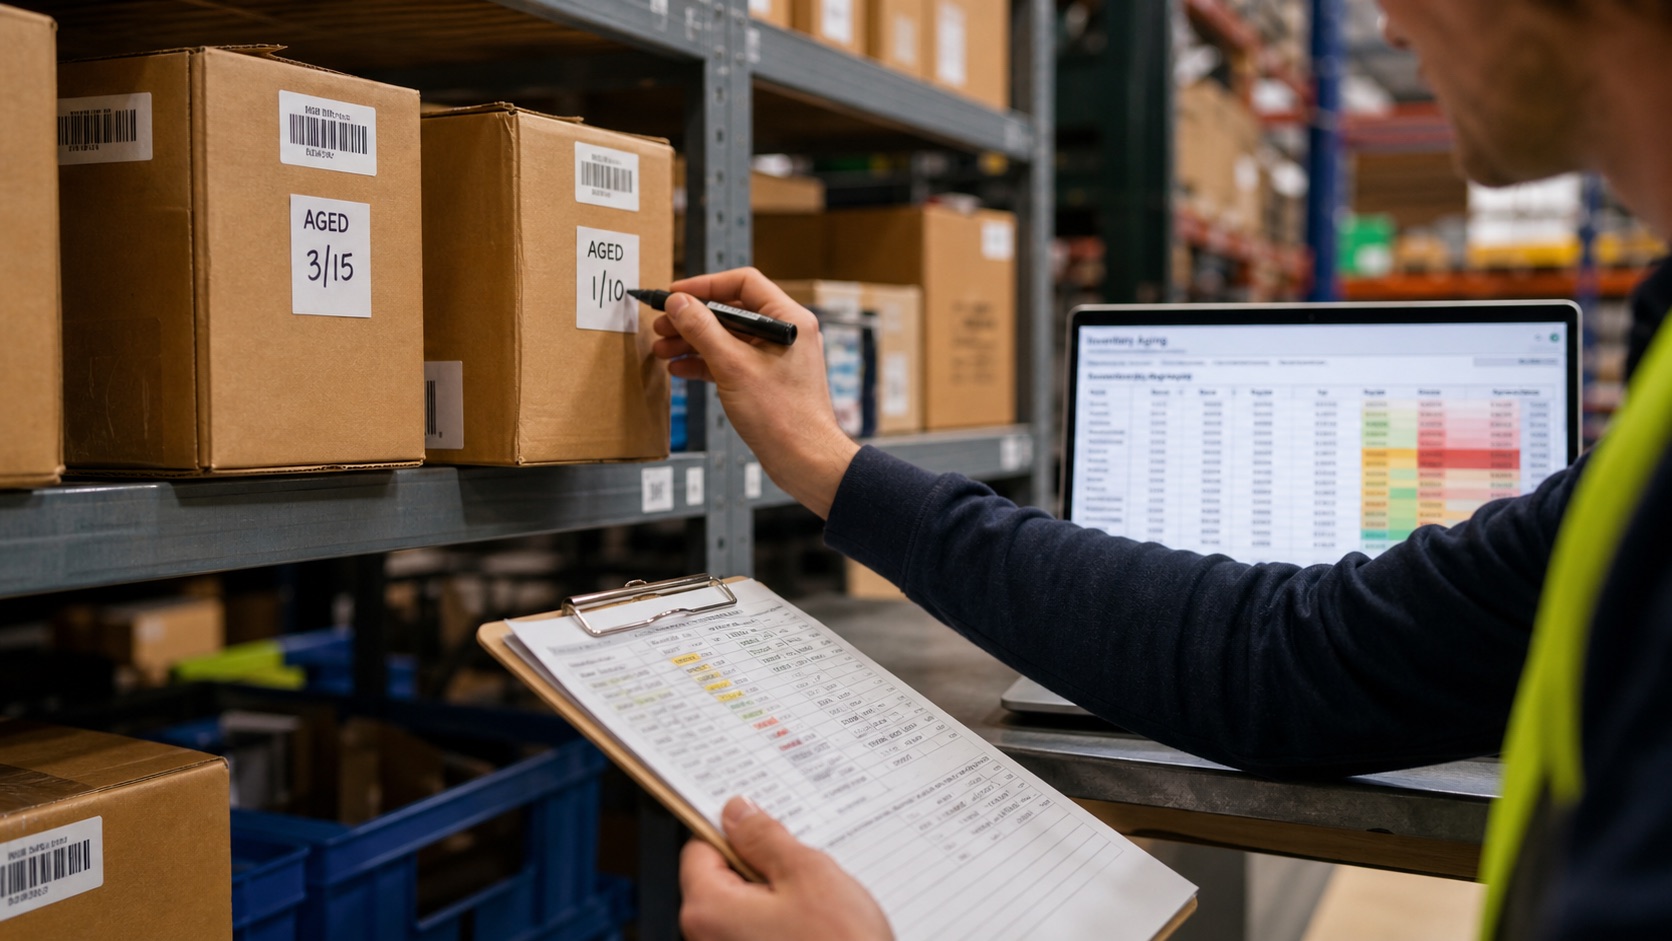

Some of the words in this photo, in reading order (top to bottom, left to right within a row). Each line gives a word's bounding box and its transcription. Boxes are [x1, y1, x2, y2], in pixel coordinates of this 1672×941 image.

[303, 208, 349, 233] AGED
[306, 244, 354, 288] 3/15
[587, 240, 624, 262] AGED
[592, 270, 624, 309] 1/10
